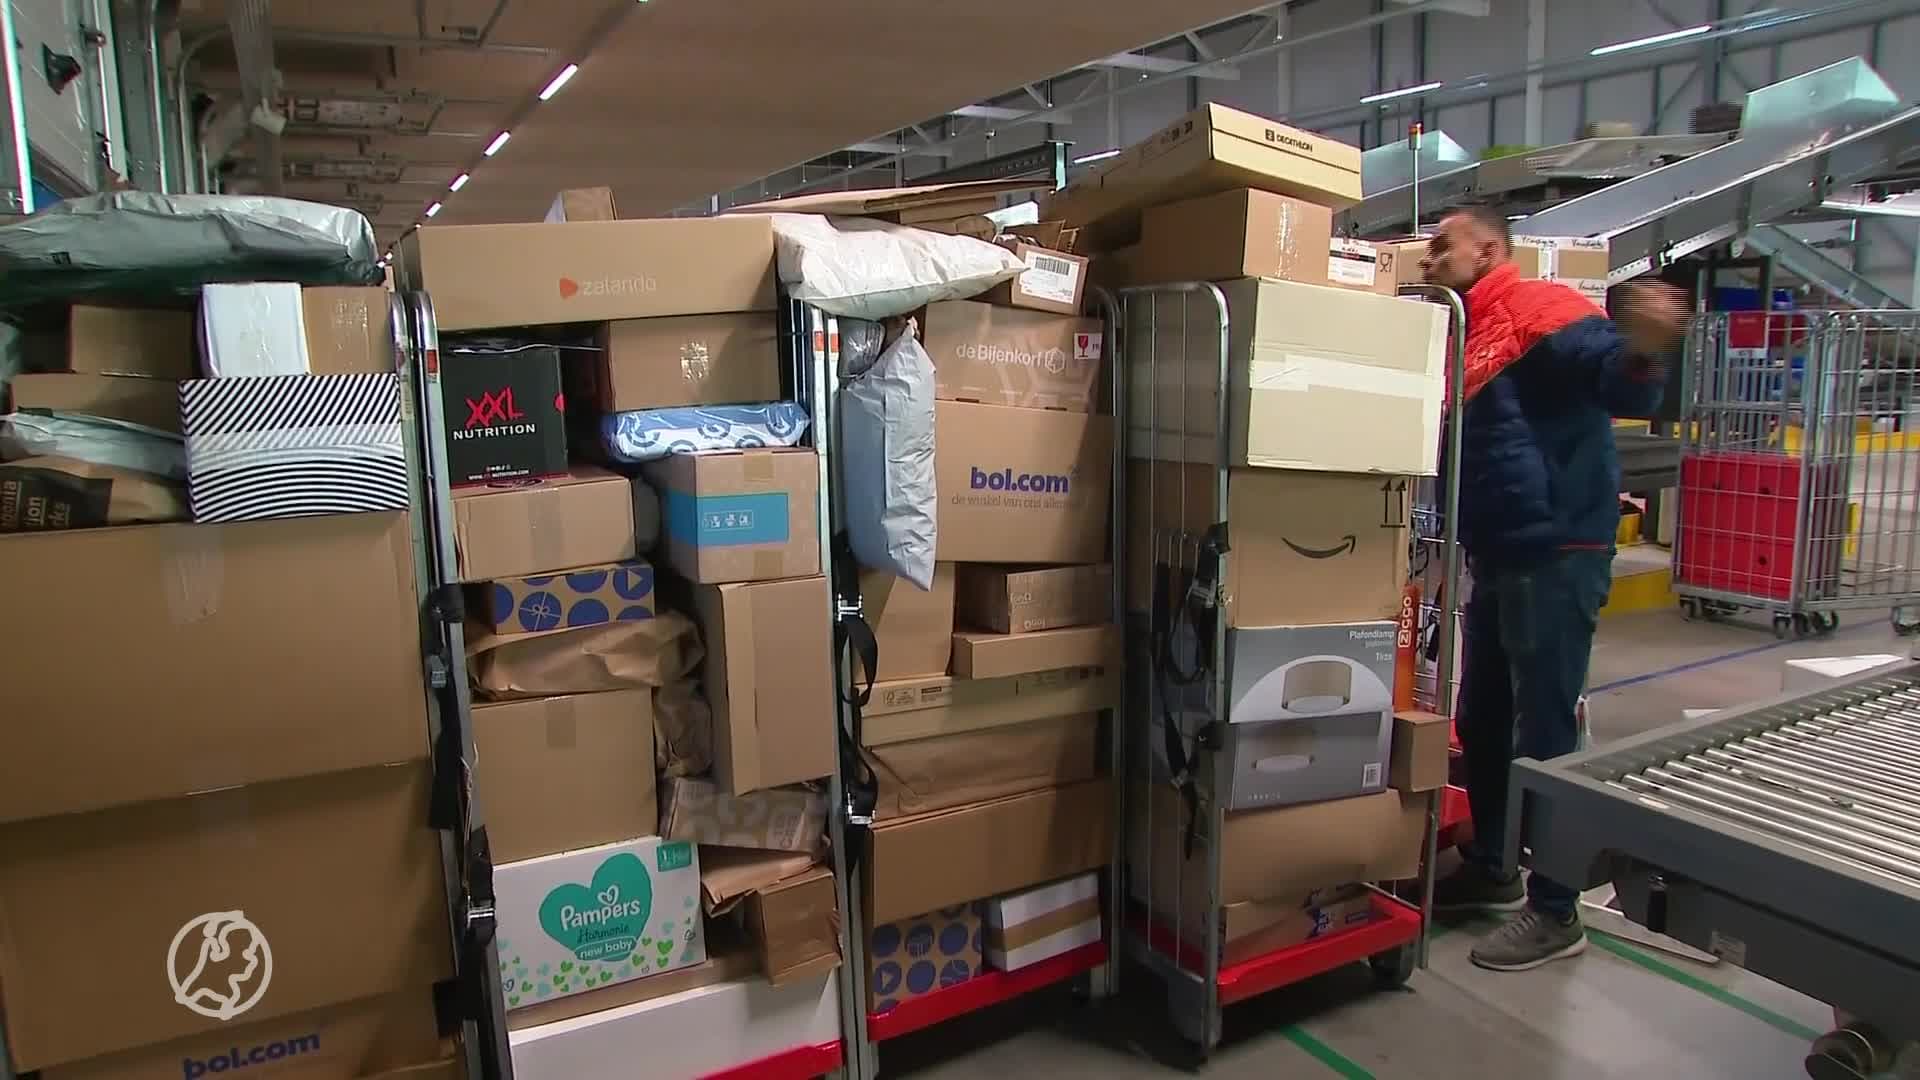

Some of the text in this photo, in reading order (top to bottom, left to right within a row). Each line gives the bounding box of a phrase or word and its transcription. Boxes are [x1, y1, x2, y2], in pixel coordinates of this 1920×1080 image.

[1276, 133, 1313, 153] DECATHLON
[583, 274, 656, 297] zalando
[464, 386, 526, 429] XXL
[452, 423, 536, 441] NUTRITION
[970, 465, 1069, 493] bol.com
[560, 900, 641, 931] Pampers
[577, 923, 630, 945] Harmonie
[579, 939, 633, 961] new baby
[183, 1033, 321, 1080] bol.com
